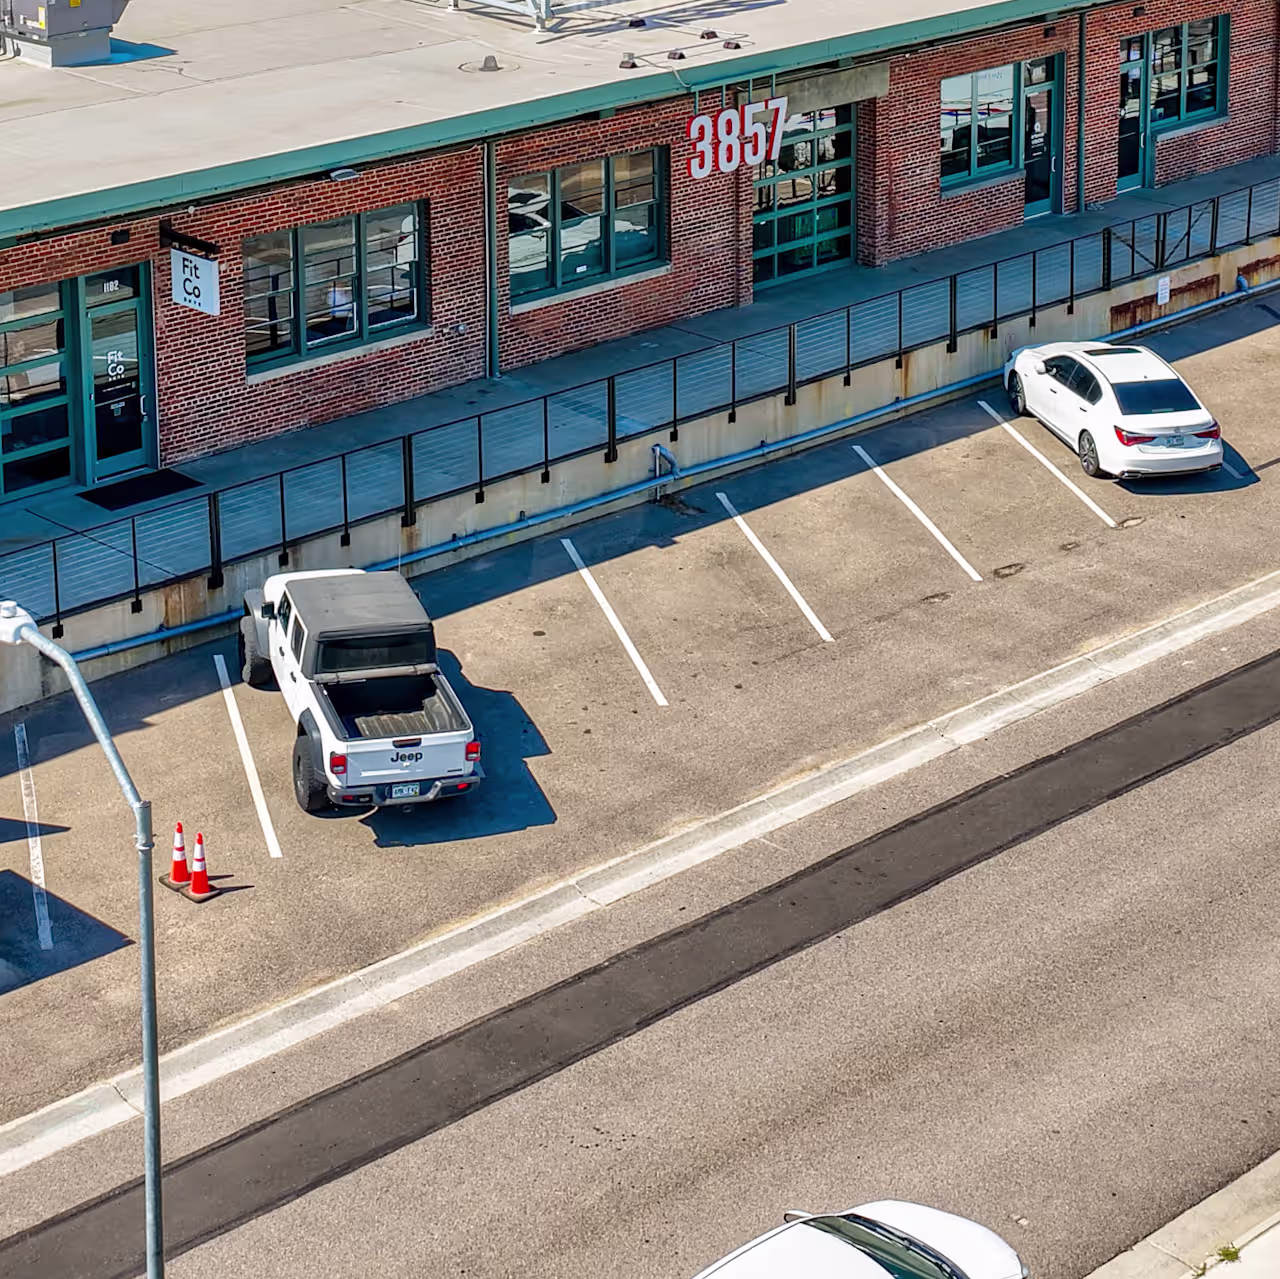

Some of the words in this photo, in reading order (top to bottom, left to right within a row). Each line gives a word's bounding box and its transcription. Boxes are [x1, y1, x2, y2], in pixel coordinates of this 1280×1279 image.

[687, 96, 788, 179] 3857
[182, 257, 200, 279] Fit
[103, 280, 119, 293] 1182
[183, 277, 201, 298] Co
[107, 351, 123, 363] Fit
[108, 363, 125, 376] Co
[390, 752, 423, 763] Jeep
